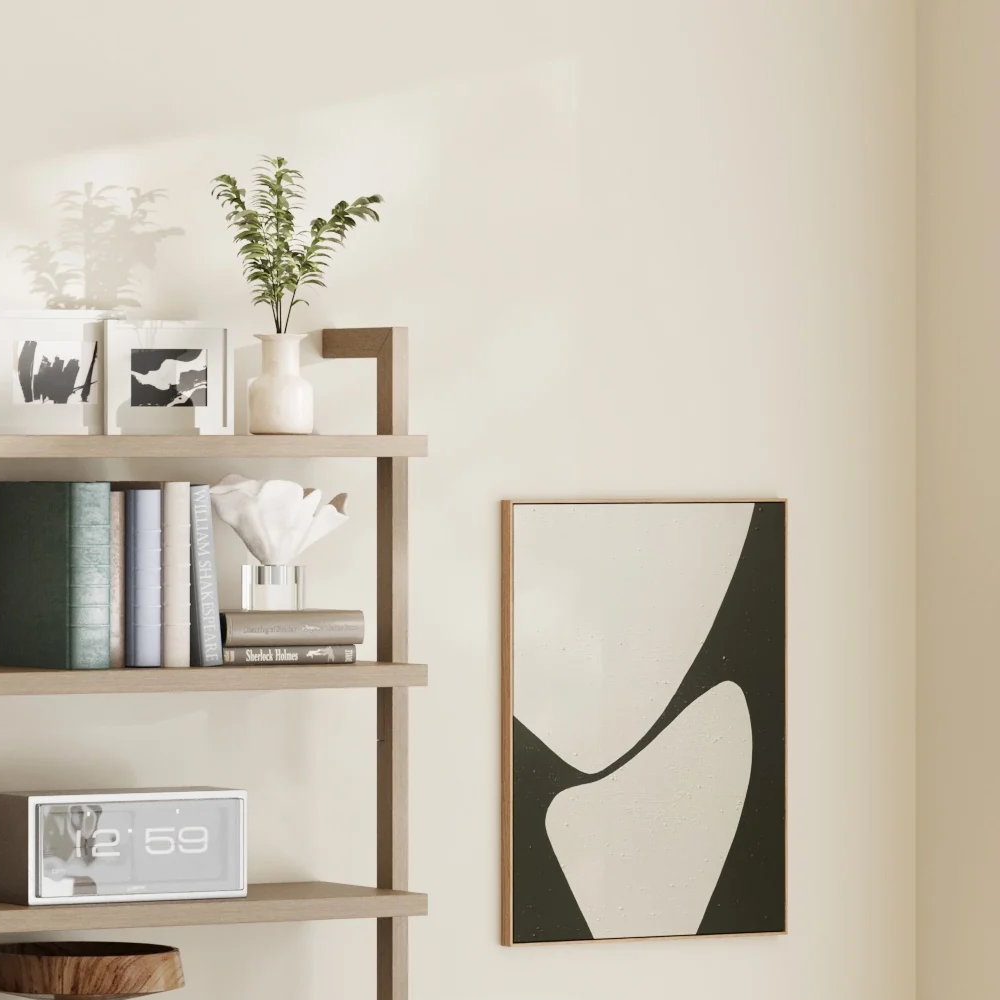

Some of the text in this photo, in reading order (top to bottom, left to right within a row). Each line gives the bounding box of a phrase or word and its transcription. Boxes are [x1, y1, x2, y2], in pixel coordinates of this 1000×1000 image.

[193, 489, 219, 662] WILLIAM SHAKESPEARE
[245, 648, 299, 662] Sherlock Holmes
[144, 826, 209, 855] 59
